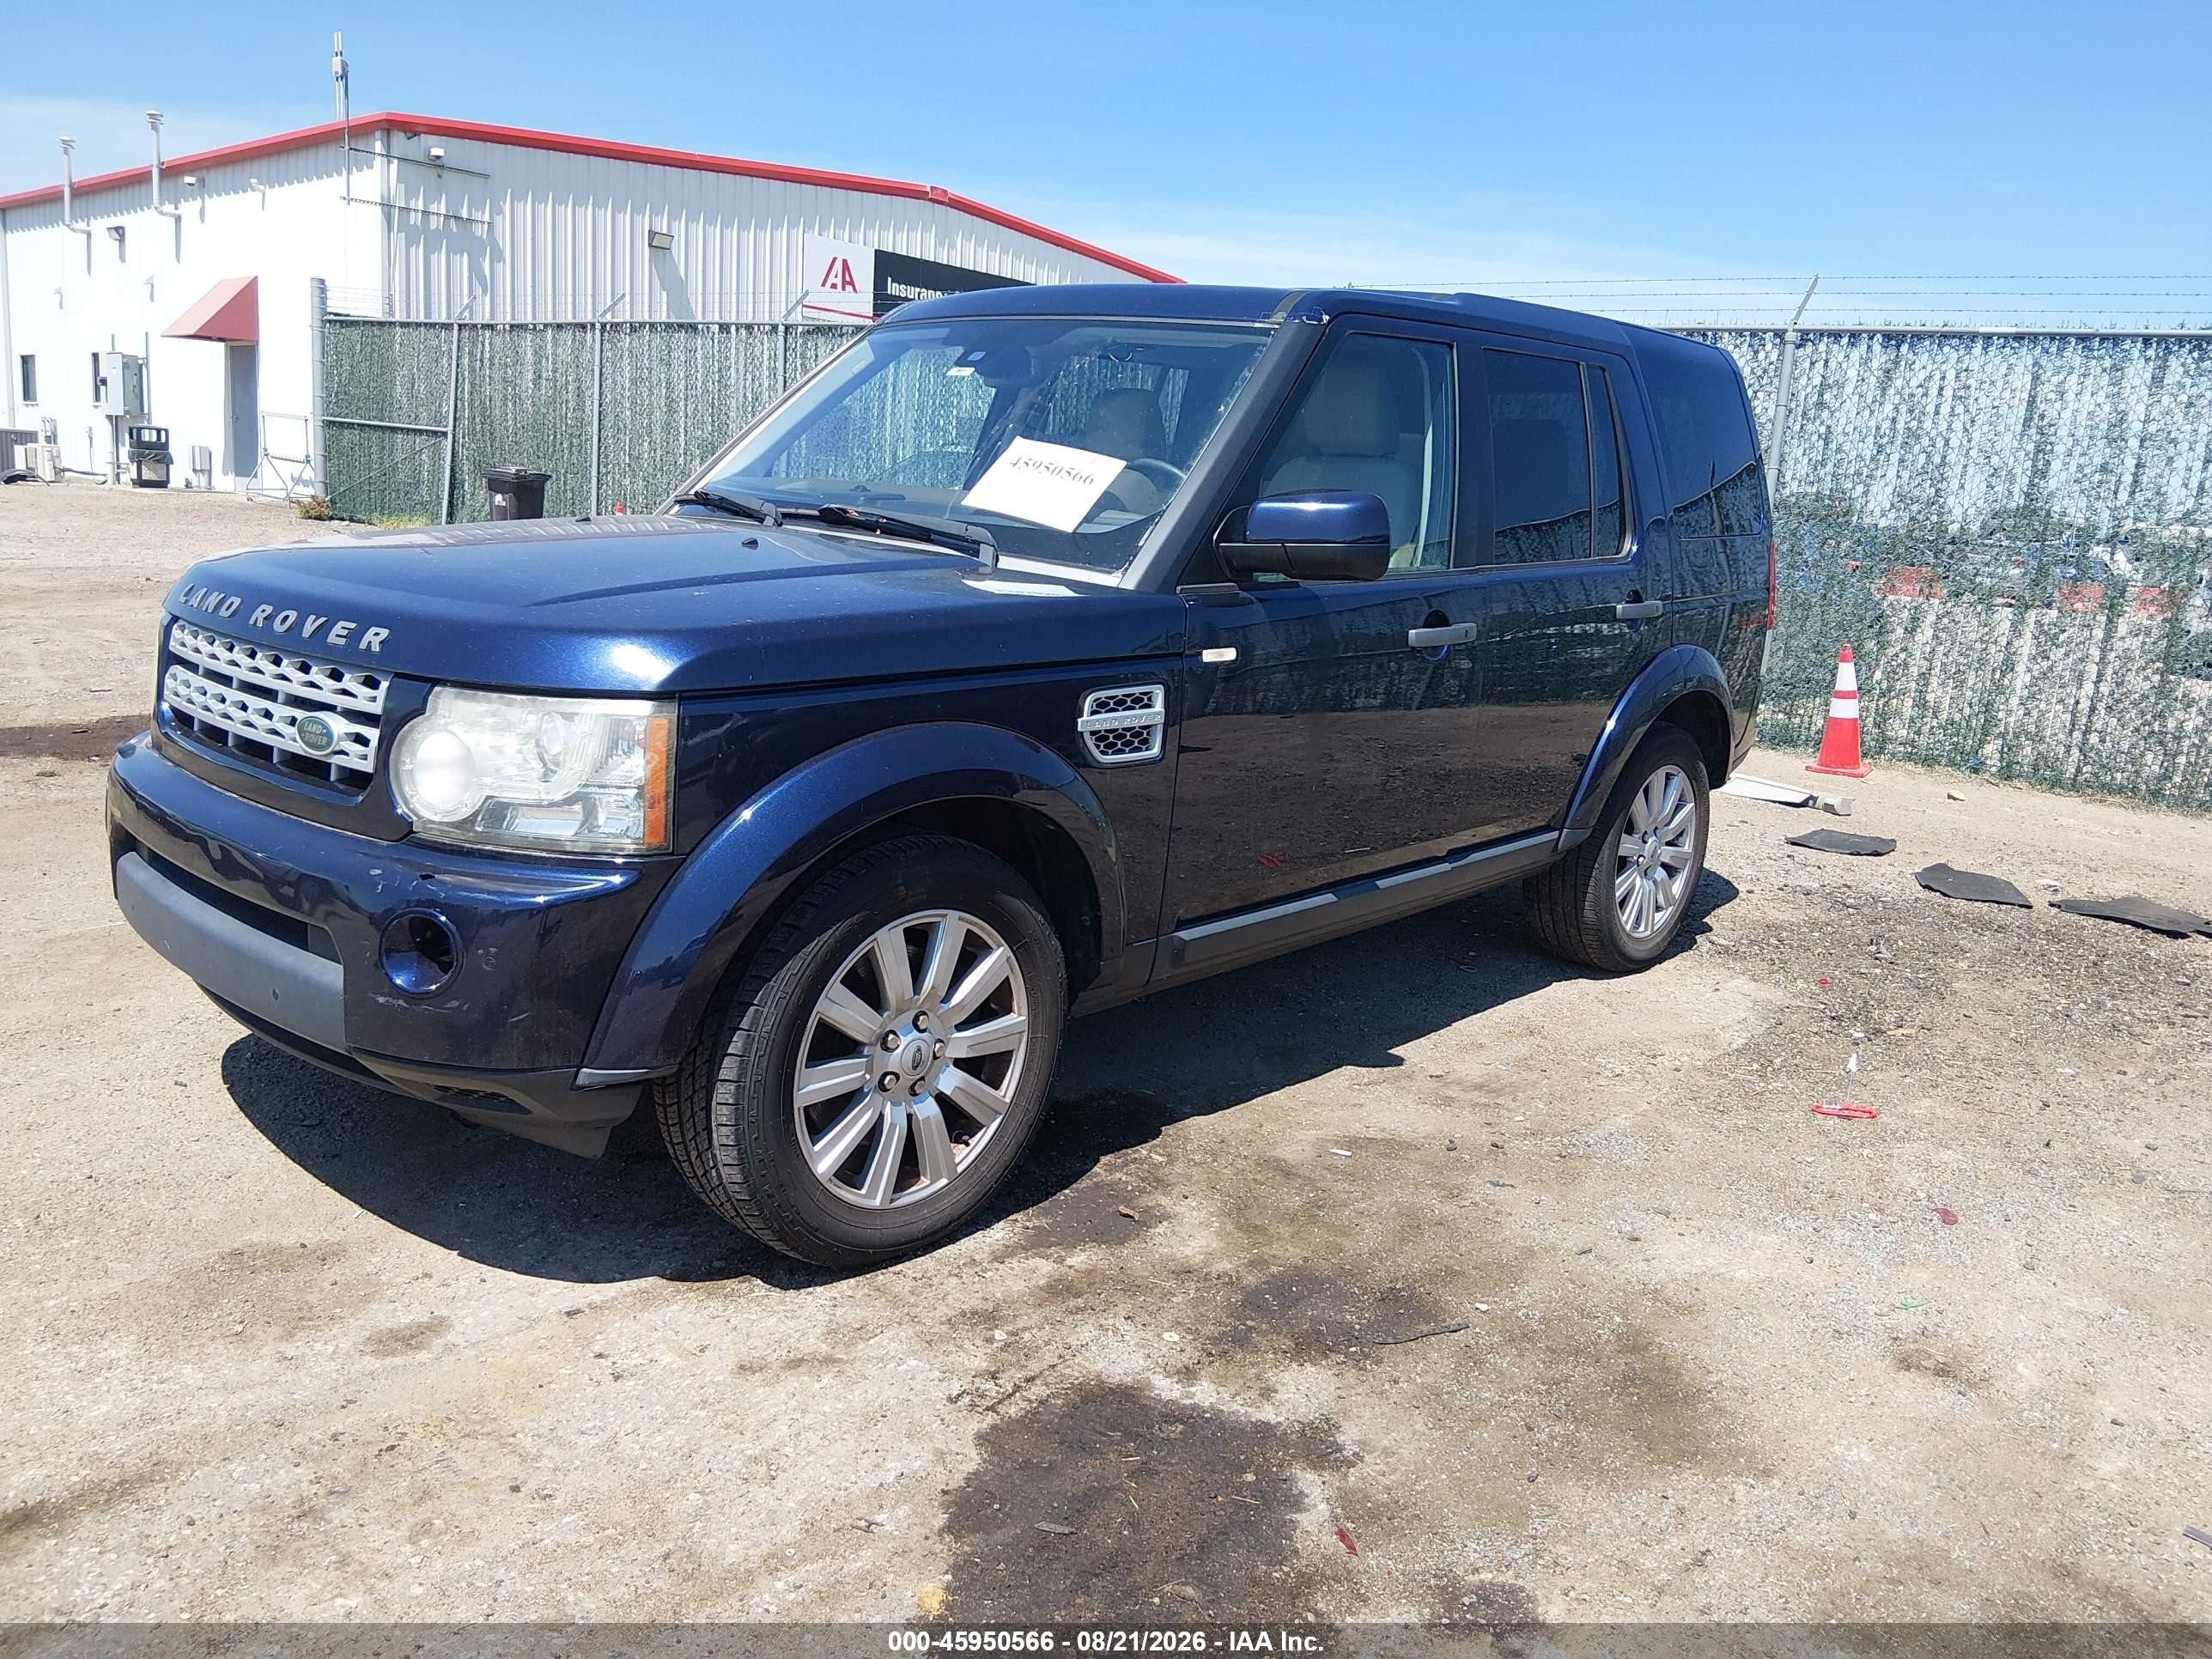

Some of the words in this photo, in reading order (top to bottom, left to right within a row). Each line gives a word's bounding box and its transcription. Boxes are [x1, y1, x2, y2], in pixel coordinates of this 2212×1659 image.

[1009, 456, 1095, 486] 45950566
[178, 583, 242, 618] LAND
[249, 604, 391, 653] ROVER
[1085, 719, 1119, 729] LAND
[1123, 714, 1162, 725] ROVER
